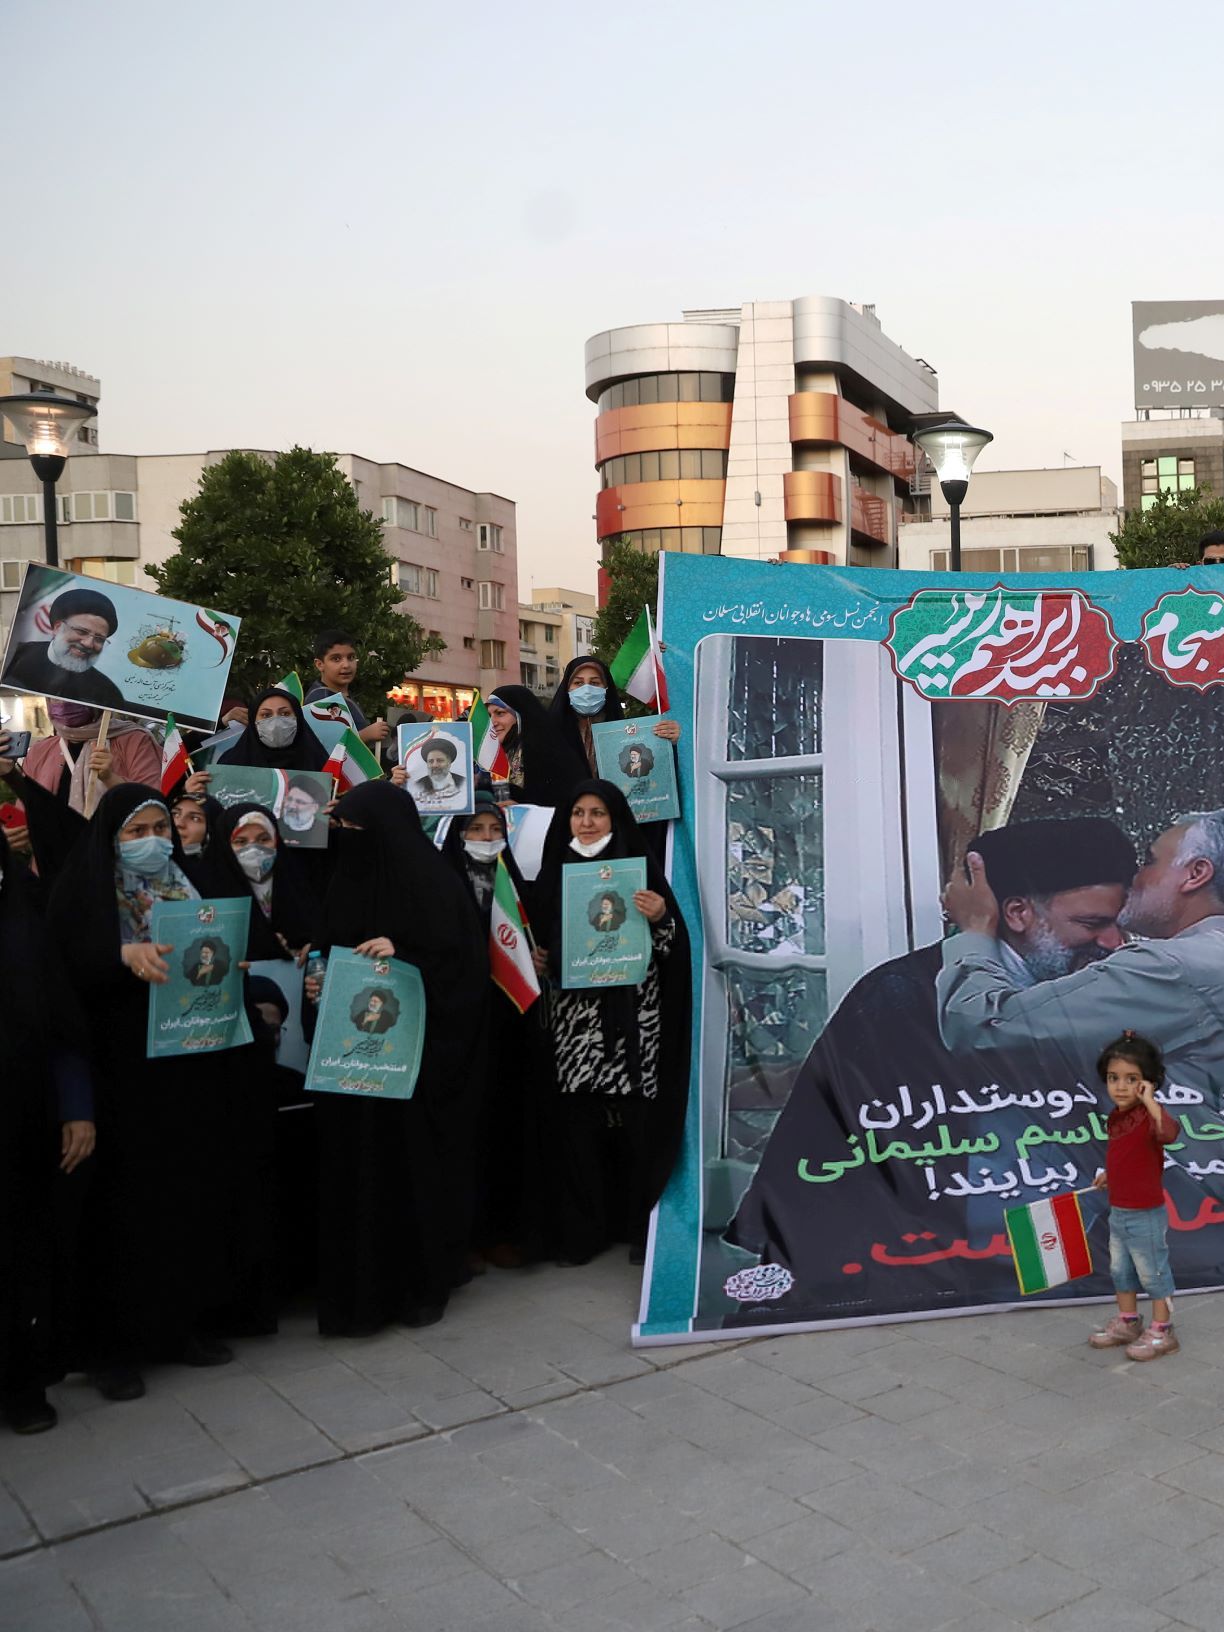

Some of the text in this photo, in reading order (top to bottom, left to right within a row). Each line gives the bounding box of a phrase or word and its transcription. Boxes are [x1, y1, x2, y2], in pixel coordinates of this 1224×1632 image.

[1143, 379, 1182, 393] ۰۹۳۵
[1186, 379, 1207, 392] ۲۵
[702, 604, 739, 621] مسلمان
[731, 601, 765, 624] انقلابی
[764, 604, 800, 625] جوانان
[805, 605, 811, 622] ها
[812, 610, 836, 627] سومی
[833, 602, 860, 628] نسل
[851, 601, 883, 629] انجمن
[858, 1083, 1098, 1129] دوستداران
[797, 1124, 1000, 1183] سلیمانی
[924, 1157, 1078, 1200] بیایند!
